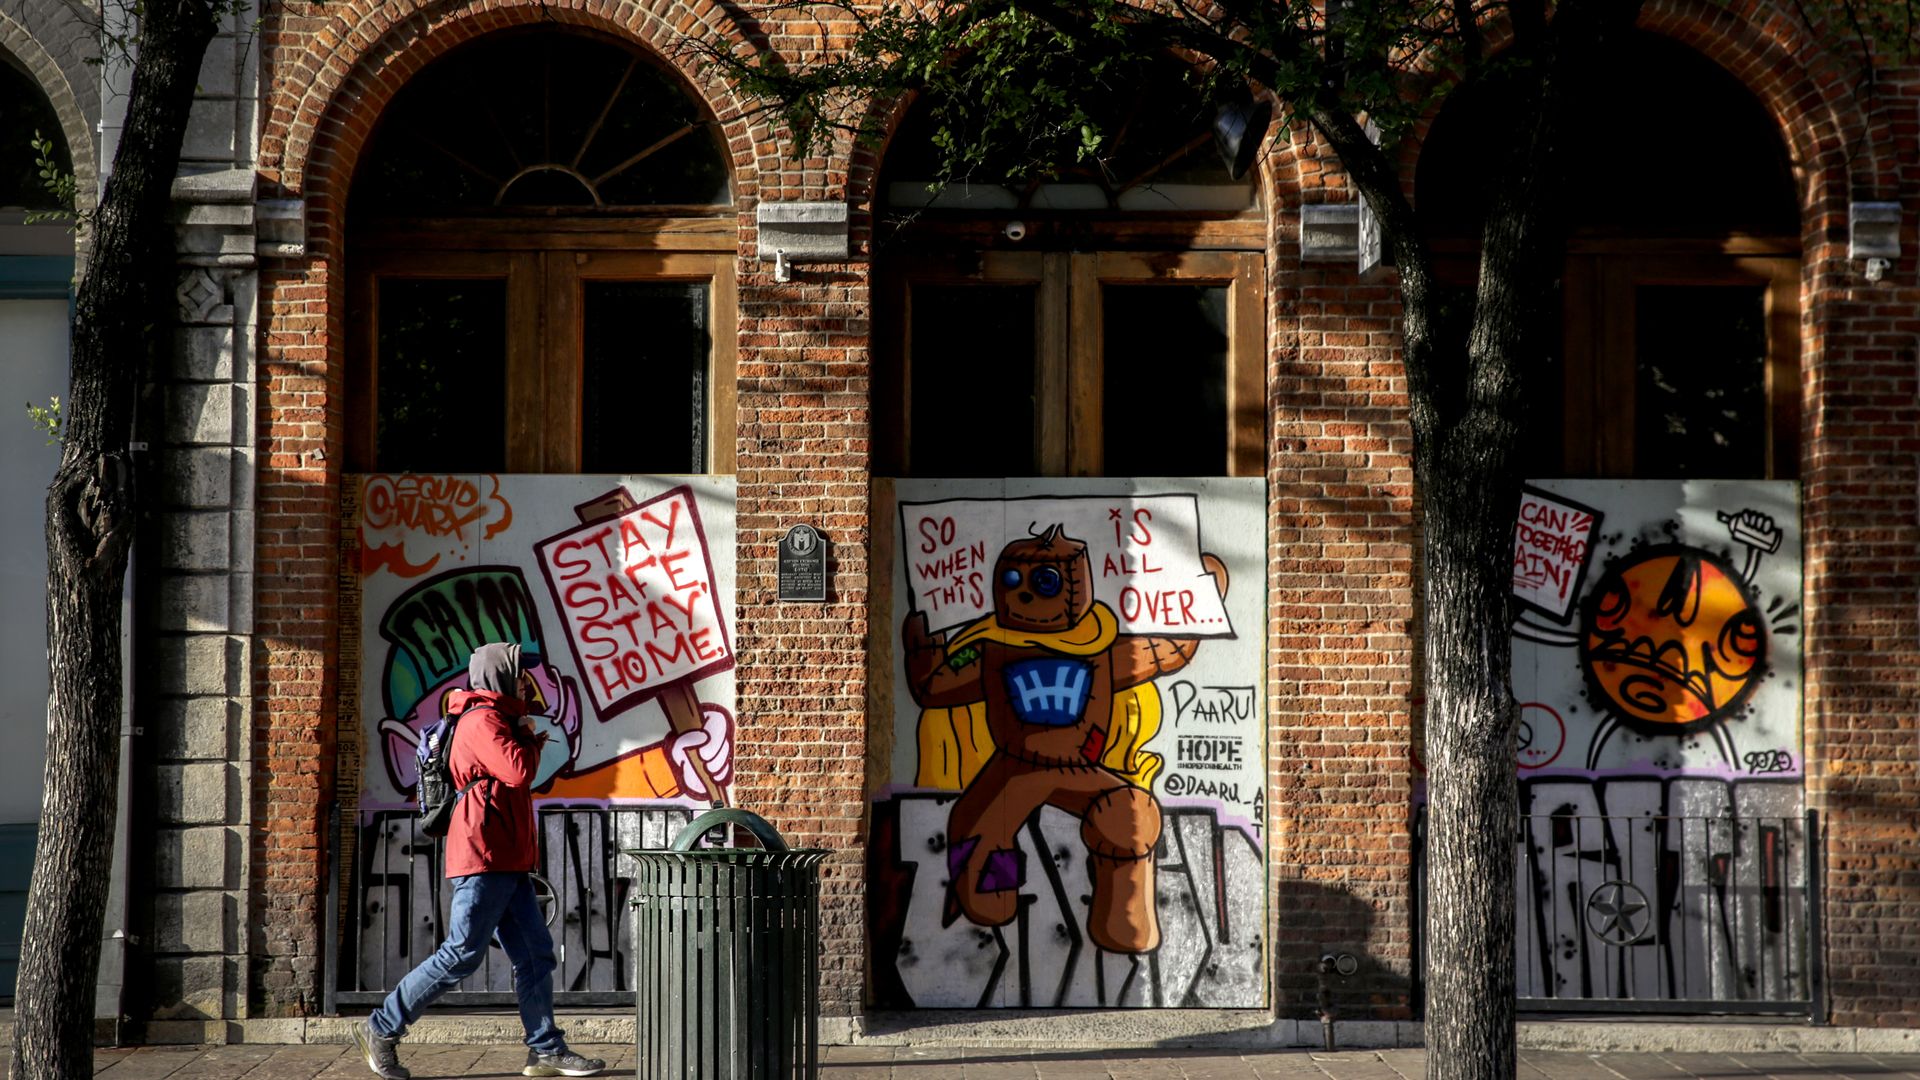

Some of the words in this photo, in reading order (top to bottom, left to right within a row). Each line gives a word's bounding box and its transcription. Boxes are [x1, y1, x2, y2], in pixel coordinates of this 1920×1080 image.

[919, 516, 955, 554] SO
[1521, 502, 1568, 533] CAN
[553, 501, 680, 580] STAY
[915, 540, 985, 580] WHEN
[1103, 553, 1163, 578] ALL
[1514, 544, 1571, 599] AIN!
[580, 590, 700, 660] STAY
[1177, 740, 1243, 762] HOPE
